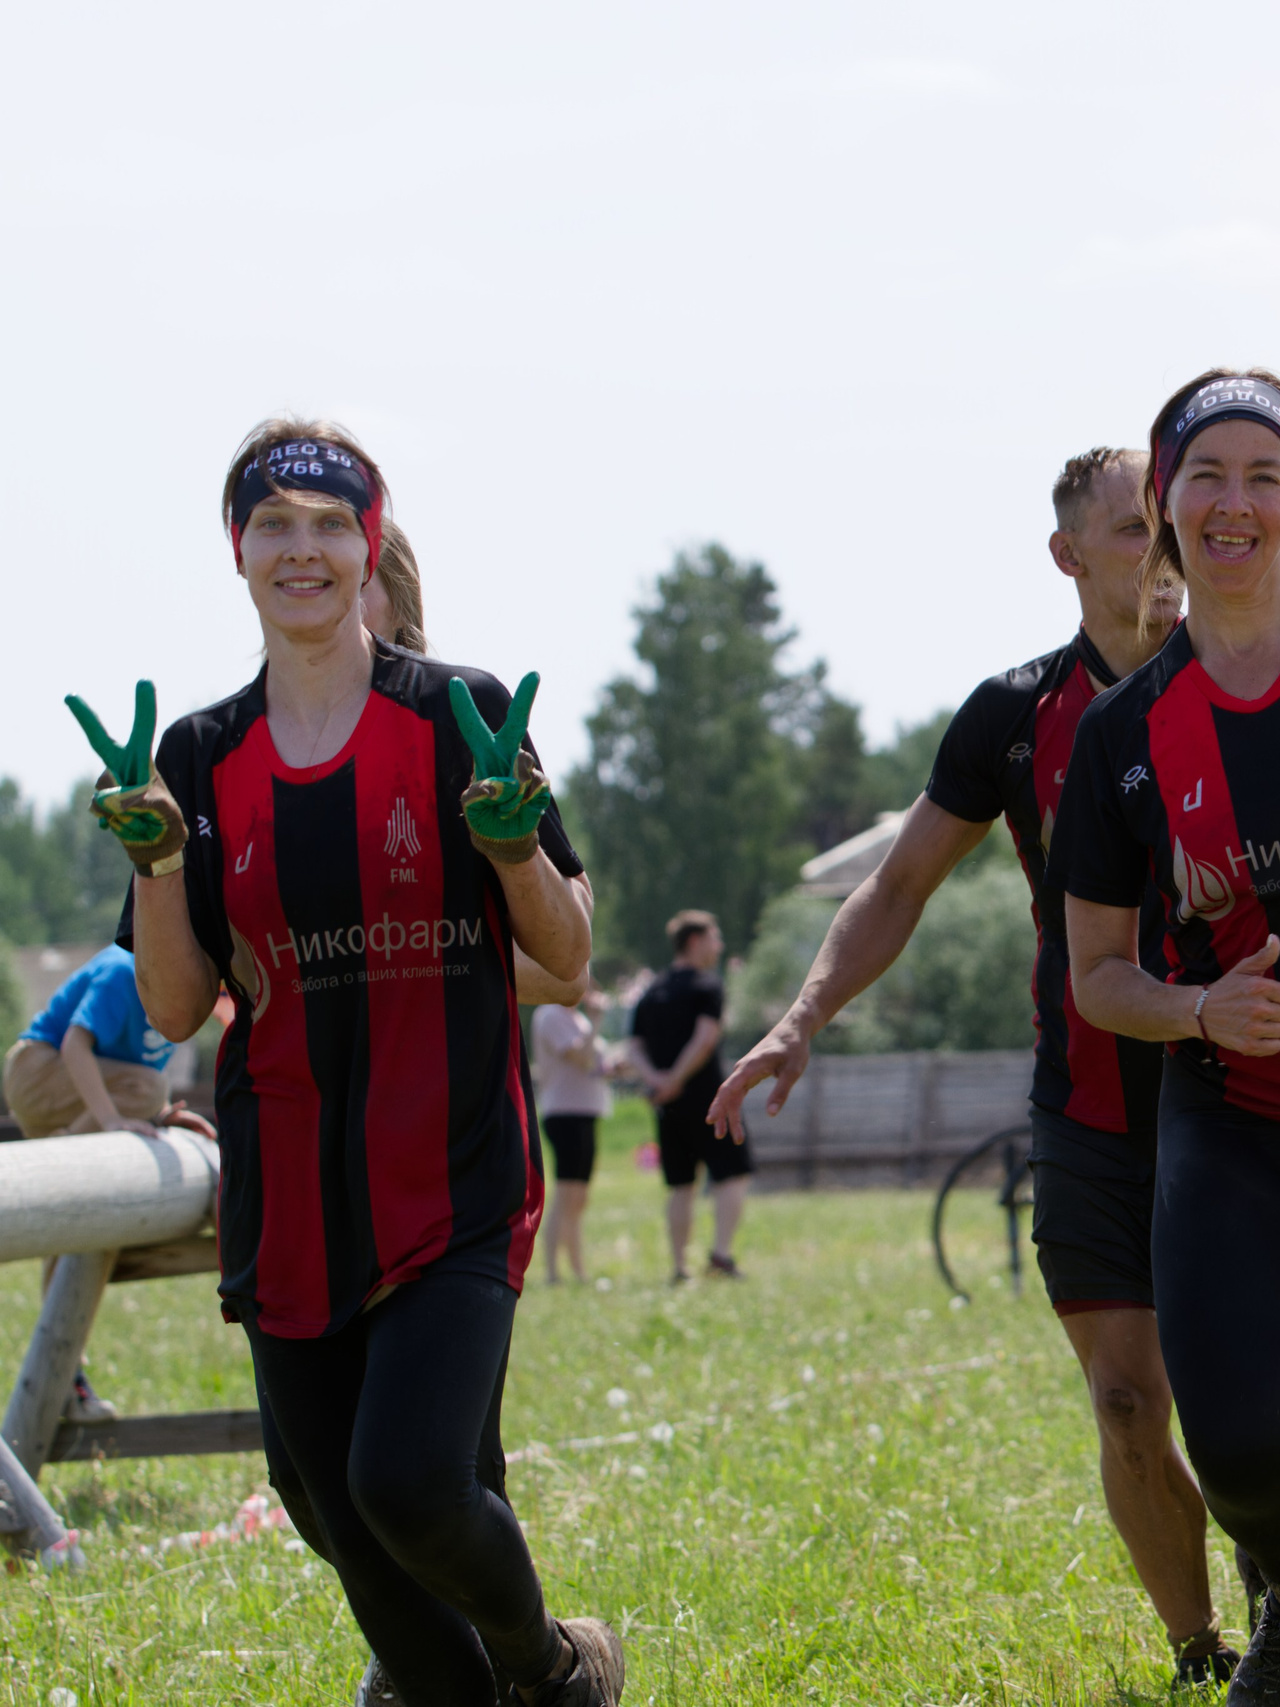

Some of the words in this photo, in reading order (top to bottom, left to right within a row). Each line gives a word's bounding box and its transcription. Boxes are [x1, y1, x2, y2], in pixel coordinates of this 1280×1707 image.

[1197, 378, 1256, 398] 2764
[1175, 407, 1196, 433] 59
[326, 448, 352, 469] 59
[268, 461, 324, 480] 2766
[390, 867, 419, 884] FML
[265, 911, 483, 970] Никофарм
[290, 975, 340, 995] Забота
[343, 972, 354, 985] о
[402, 962, 471, 980] клиентах
